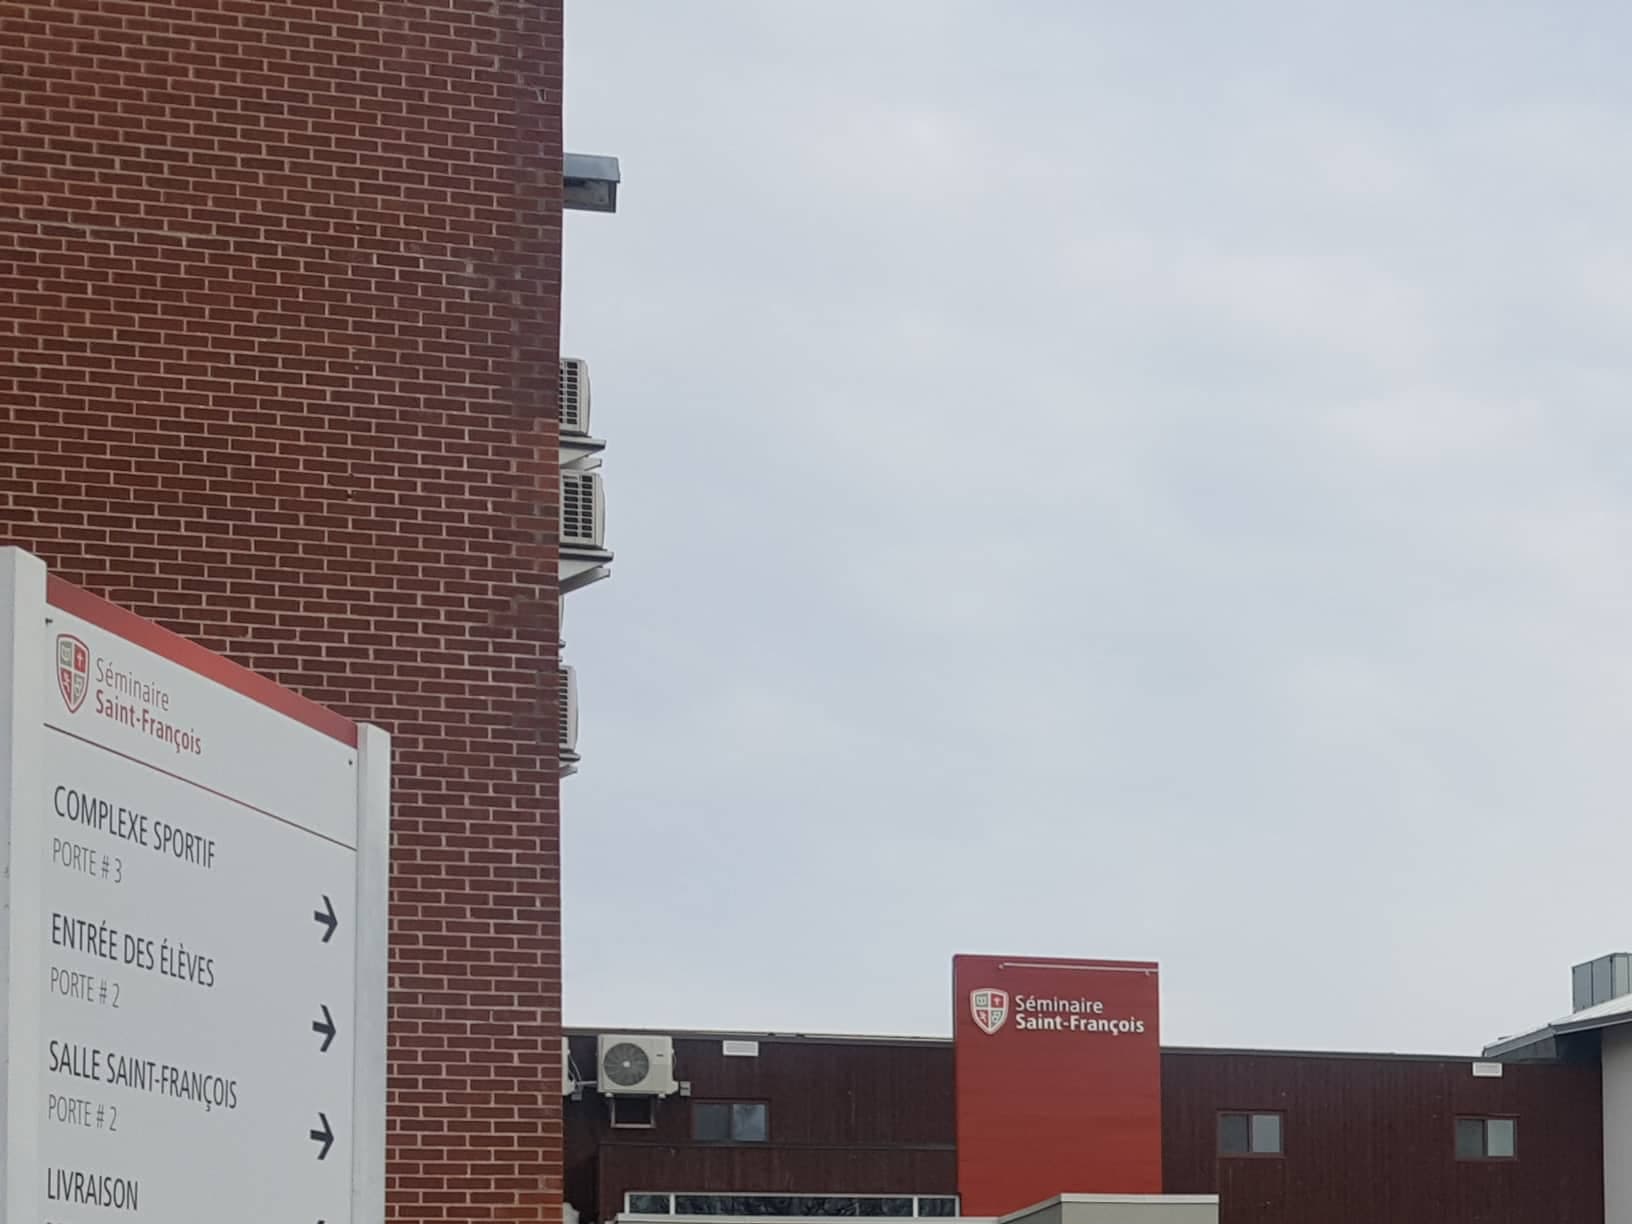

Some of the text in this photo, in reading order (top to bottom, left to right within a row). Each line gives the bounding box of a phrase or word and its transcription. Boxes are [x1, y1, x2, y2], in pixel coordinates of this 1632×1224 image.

[96, 657, 169, 711] Séminaire
[96, 689, 201, 755] Saint-François
[54, 785, 215, 869] COMPLEXE SPORTIF
[53, 837, 122, 884] PORTE # 3
[52, 913, 214, 987] ENTRÉE DES ÉLÈVES
[51, 966, 120, 1008] PORTE # 2
[1015, 995, 1103, 1014] Séminaire
[1015, 1013, 1145, 1036] Saint-François
[49, 1039, 237, 1112] SALLE SAINT-FRANÇOIS
[48, 1094, 117, 1132] PORTE # 2
[48, 1167, 138, 1211] LIVRAISON
